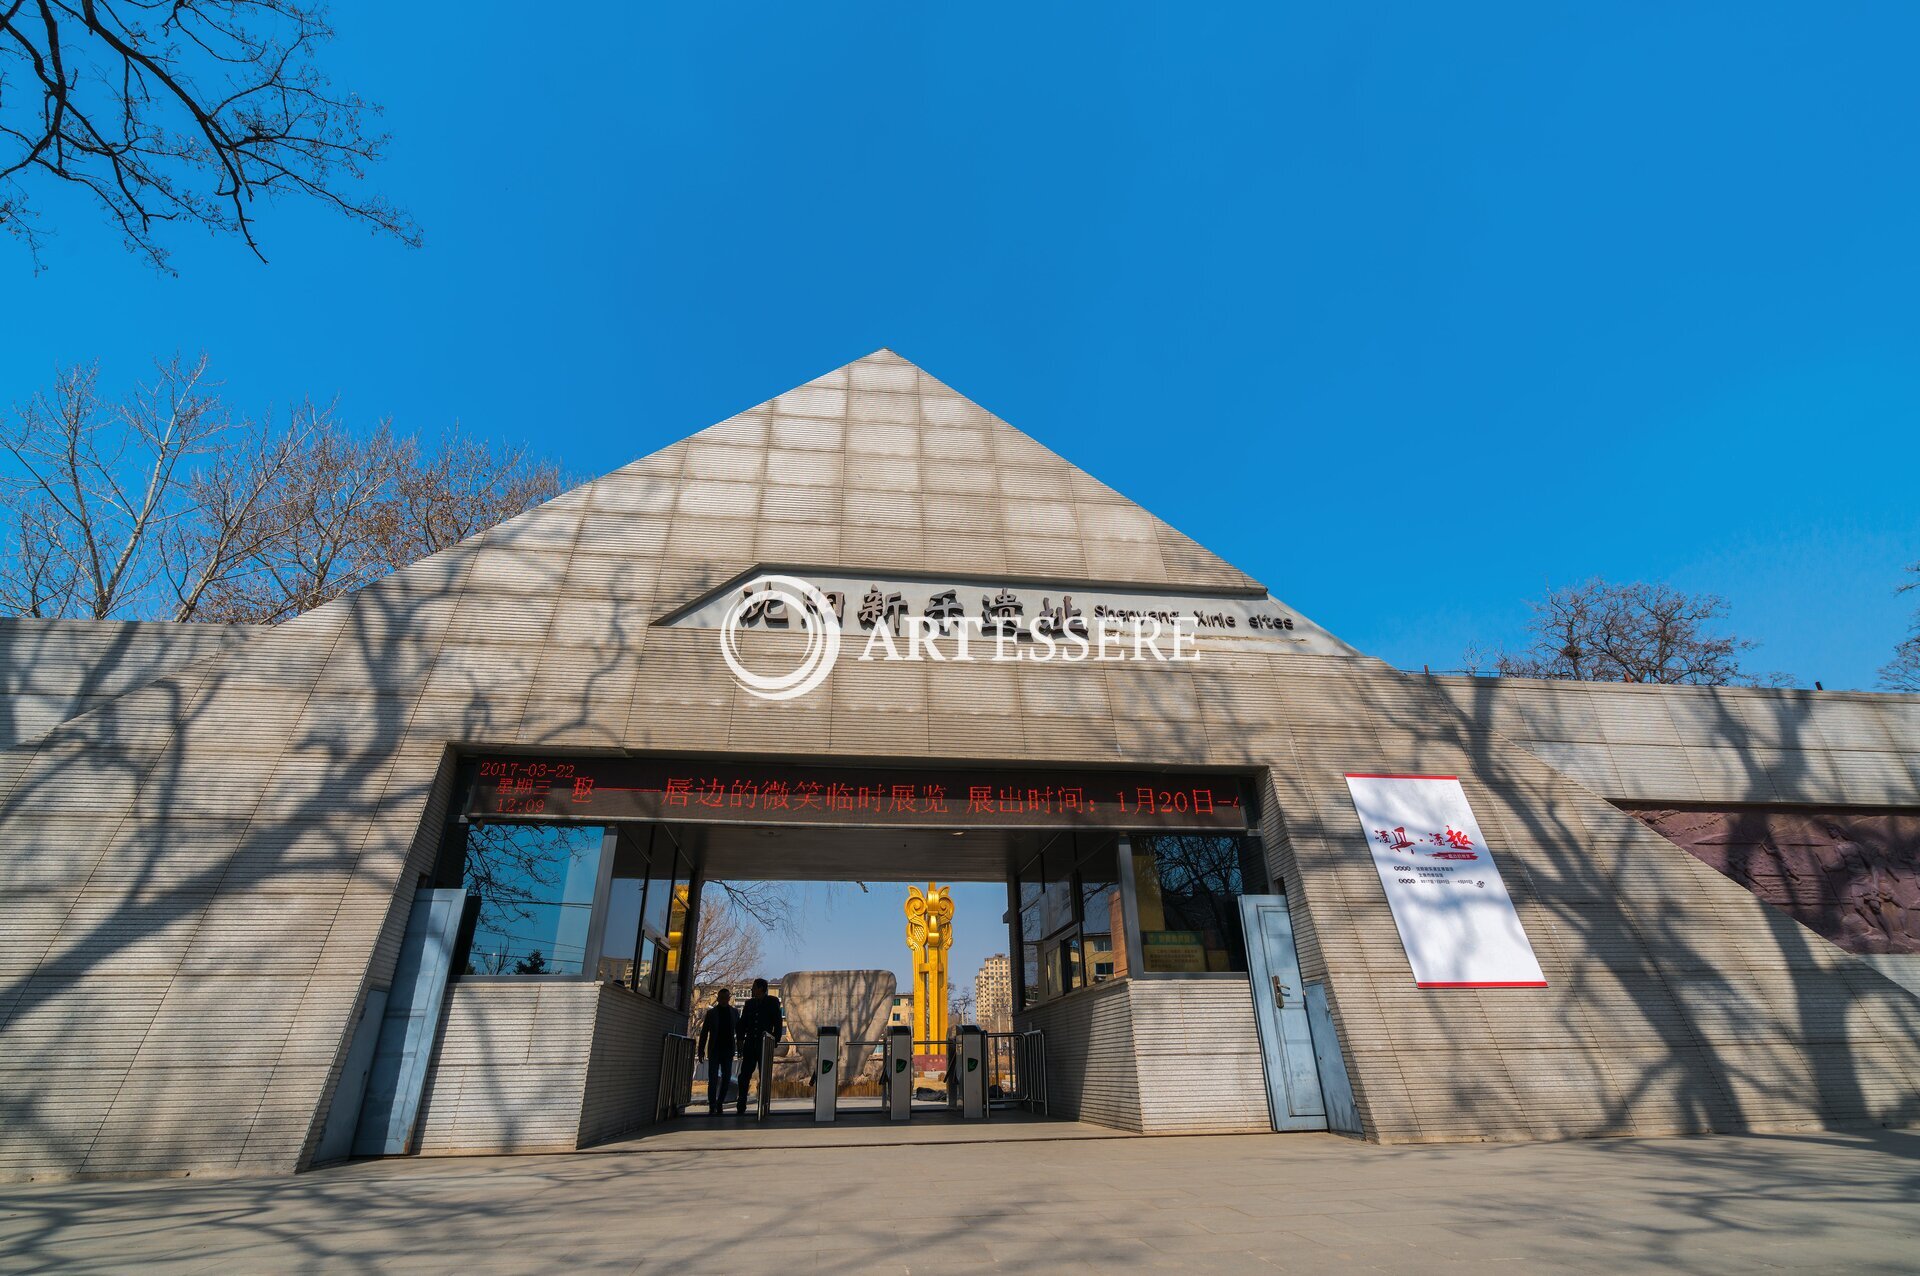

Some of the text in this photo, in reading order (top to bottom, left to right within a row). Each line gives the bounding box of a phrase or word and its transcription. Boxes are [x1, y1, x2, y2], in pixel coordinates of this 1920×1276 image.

[1248, 613, 1295, 632] sites
[480, 762, 575, 779] 2017-03-22
[496, 778, 552, 796] 星期三
[496, 798, 545, 813] 12:09
